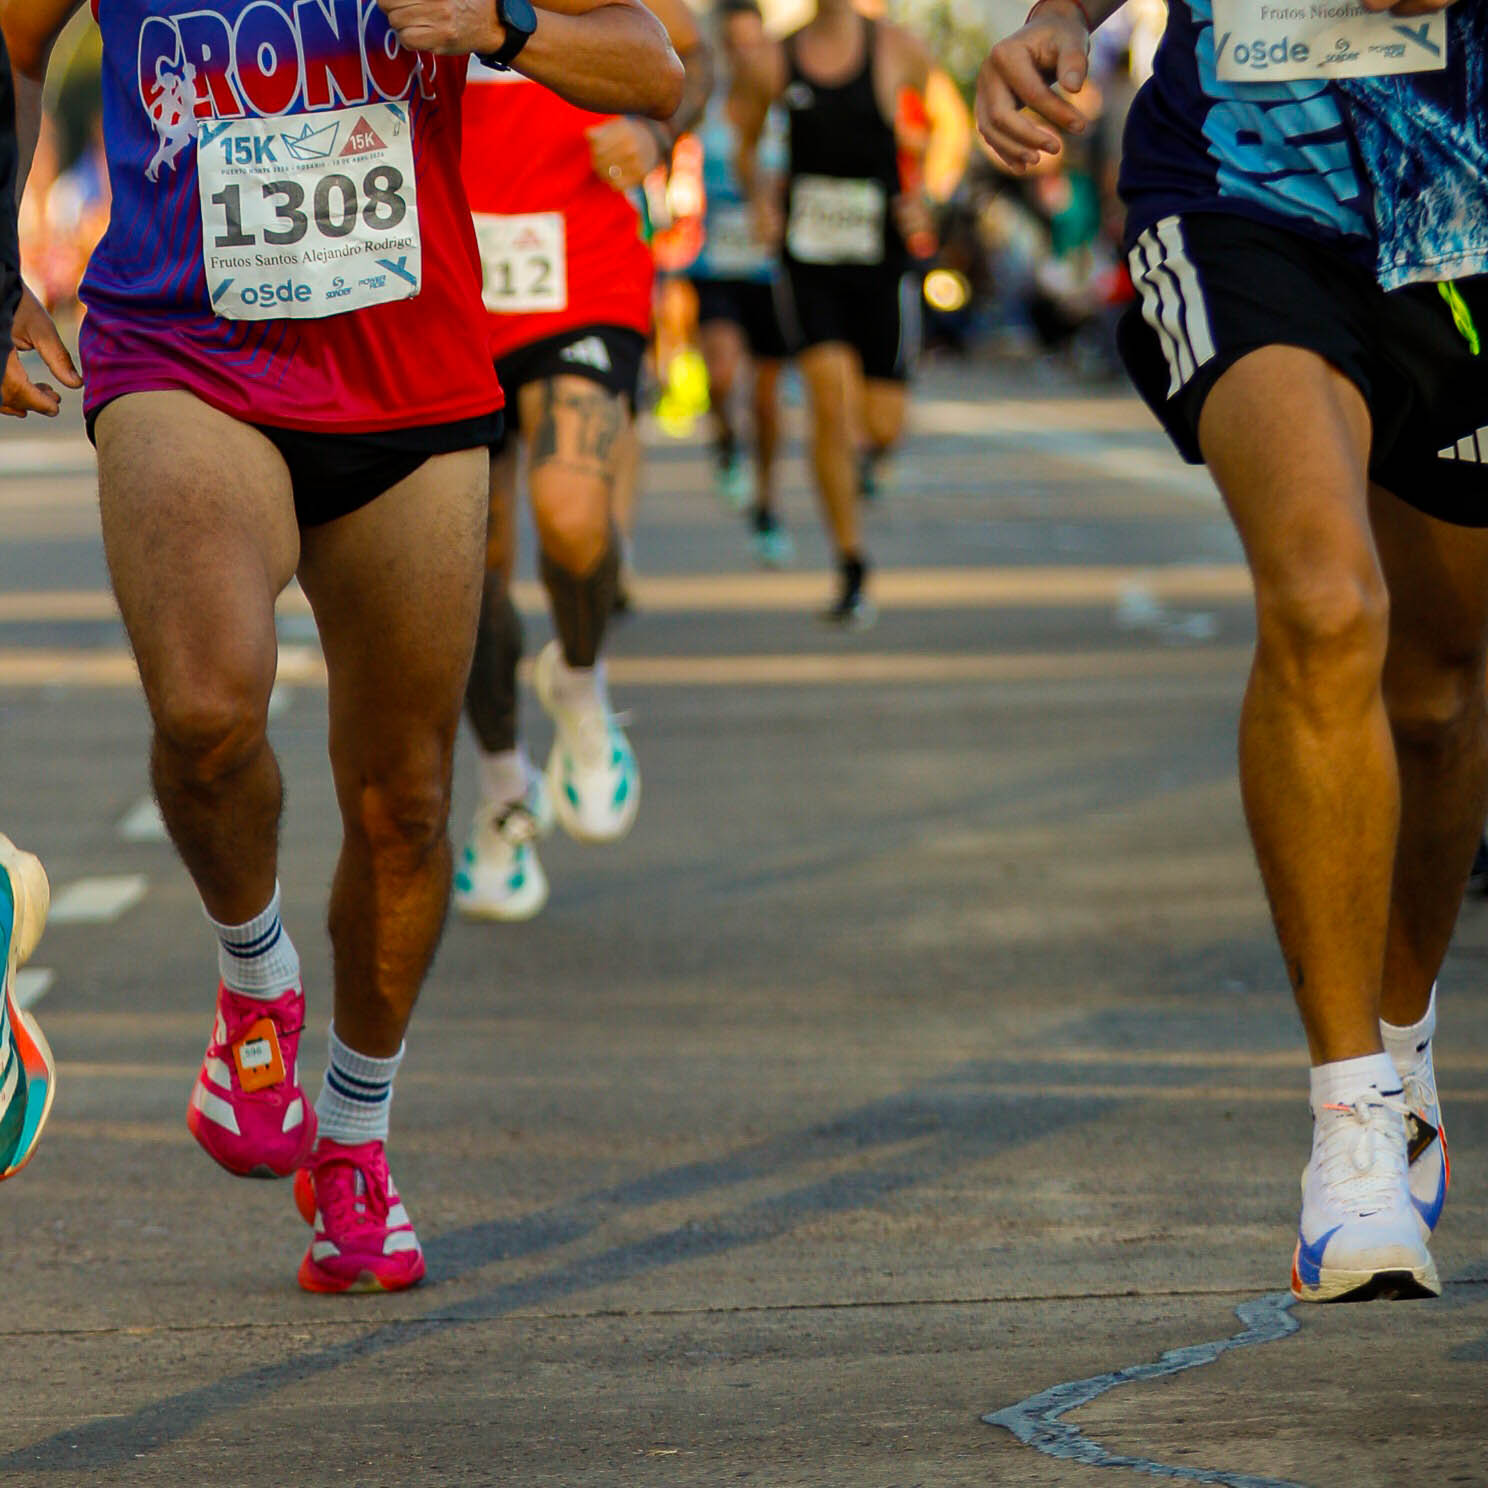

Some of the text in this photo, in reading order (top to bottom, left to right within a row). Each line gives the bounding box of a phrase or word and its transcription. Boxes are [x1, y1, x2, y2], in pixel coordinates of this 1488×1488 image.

[1233, 36, 1310, 69] osde
[220, 135, 279, 166] 15K
[350, 131, 376, 150] 15K
[211, 165, 407, 248] 1308
[210, 236, 413, 270] Frutos Santos Alejandro Rodrigo
[482, 254, 555, 298] 12
[240, 278, 312, 308] osde
